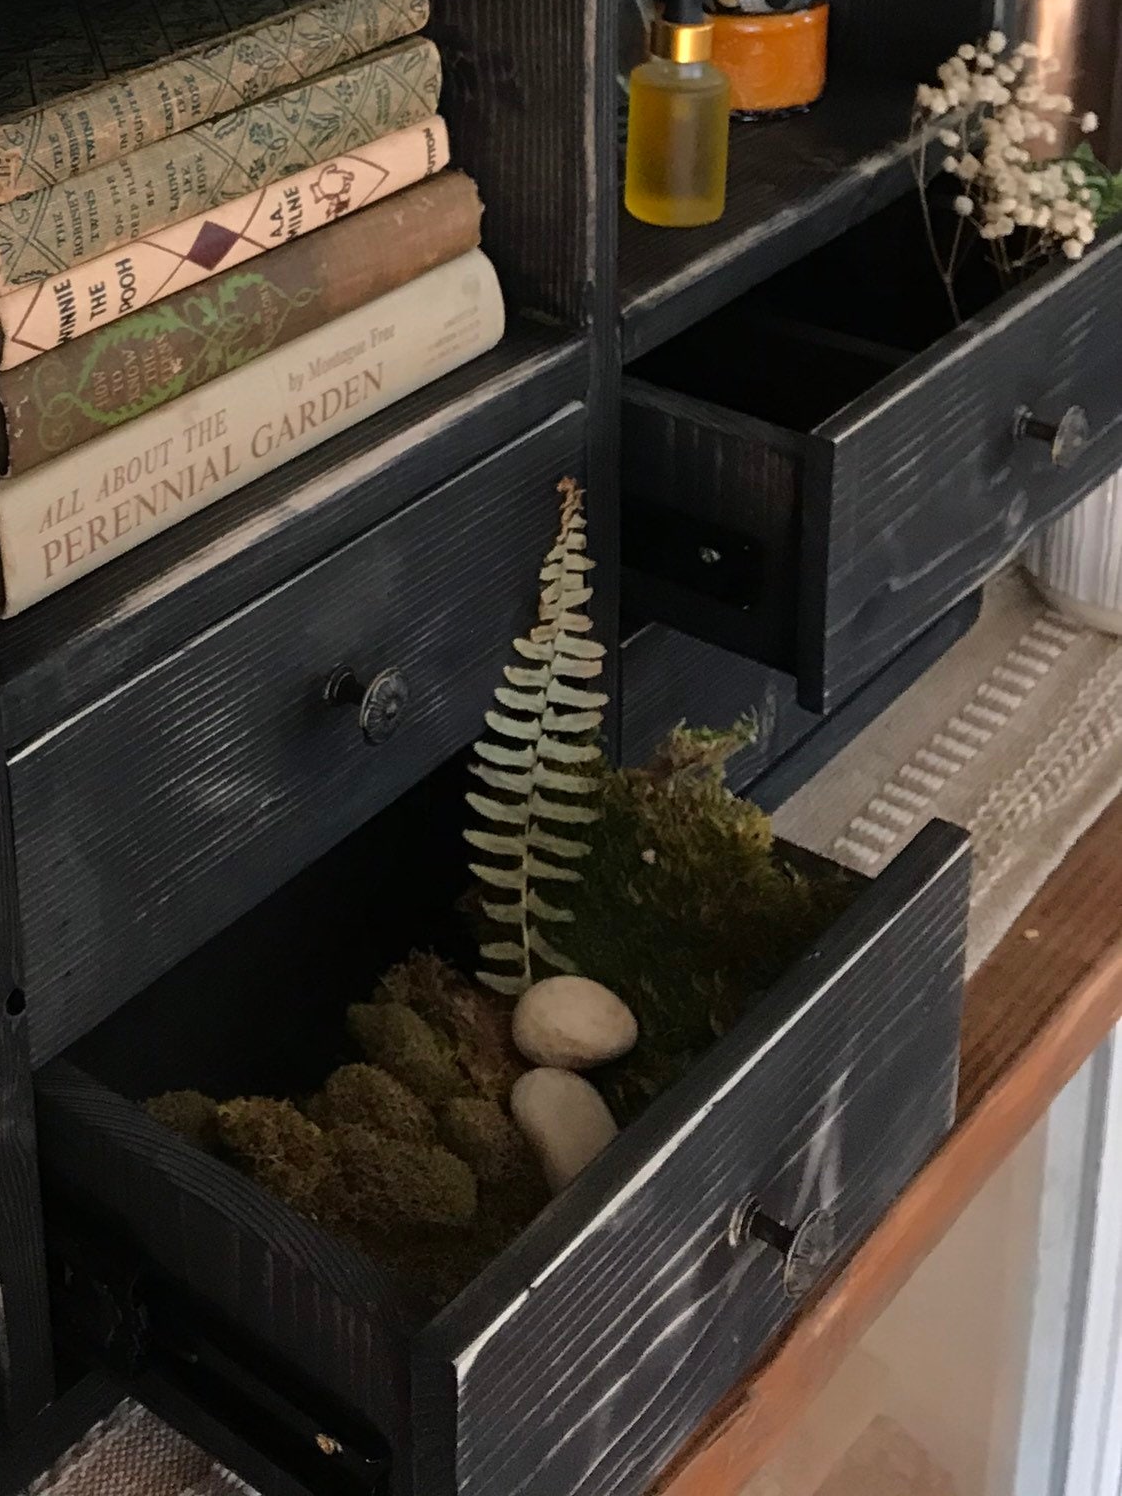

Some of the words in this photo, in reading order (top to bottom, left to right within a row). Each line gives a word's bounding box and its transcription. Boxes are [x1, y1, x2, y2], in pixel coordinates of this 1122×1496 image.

[108, 95, 123, 129] THE
[158, 80, 175, 134] LAURA
[174, 87, 186, 113] LEE
[183, 73, 201, 116] HOPE
[48, 132, 64, 169] THE
[79, 110, 96, 164] TWINS
[119, 133, 128, 150] IN
[106, 175, 121, 205] THE
[144, 180, 155, 207] SEA
[165, 159, 180, 212] LAURA
[182, 165, 193, 194] LEE
[193, 153, 207, 196] HOPE
[52, 212, 67, 248] THE
[84, 189, 100, 243] TWINS
[114, 214, 125, 236] ON
[130, 204, 140, 240] DEEP
[284, 186, 303, 240] MILNE
[88, 280, 107, 322] THE
[115, 258, 137, 315] POOH
[53, 278, 77, 345] WINNIE
[92, 370, 111, 408] HOW
[112, 369, 124, 395] TO
[122, 349, 144, 404] KNOW
[288, 373, 304, 392] by
[39, 488, 85, 534] ALL
[96, 438, 174, 502] ABOUT
[183, 408, 227, 454] THE
[41, 443, 240, 580] PERENNIAL
[251, 362, 384, 458] GARDEN
